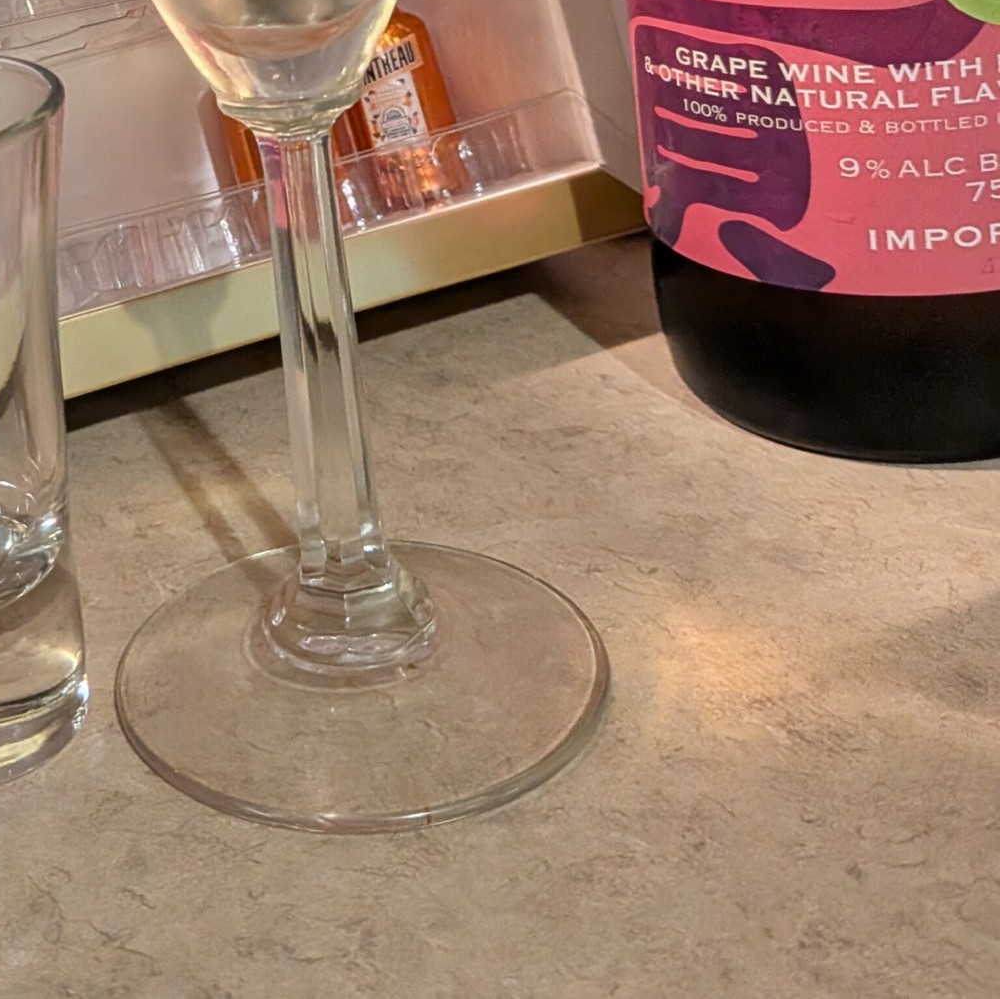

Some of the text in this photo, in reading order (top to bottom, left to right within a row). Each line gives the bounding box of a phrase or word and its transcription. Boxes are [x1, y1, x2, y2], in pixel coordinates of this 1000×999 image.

[363, 40, 416, 86] INTREAU
[675, 46, 769, 80] GRAPE
[779, 62, 875, 84] WINE
[888, 57, 983, 83] WITH
[659, 64, 741, 101] OTHER
[750, 84, 919, 110] NATURAL
[931, 81, 1000, 107] FLA
[683, 98, 727, 122] 100%
[736, 112, 850, 134] PRODUCED
[858, 119, 876, 134] &
[885, 114, 988, 134] BOTTLED
[898, 156, 966, 179] ALC
